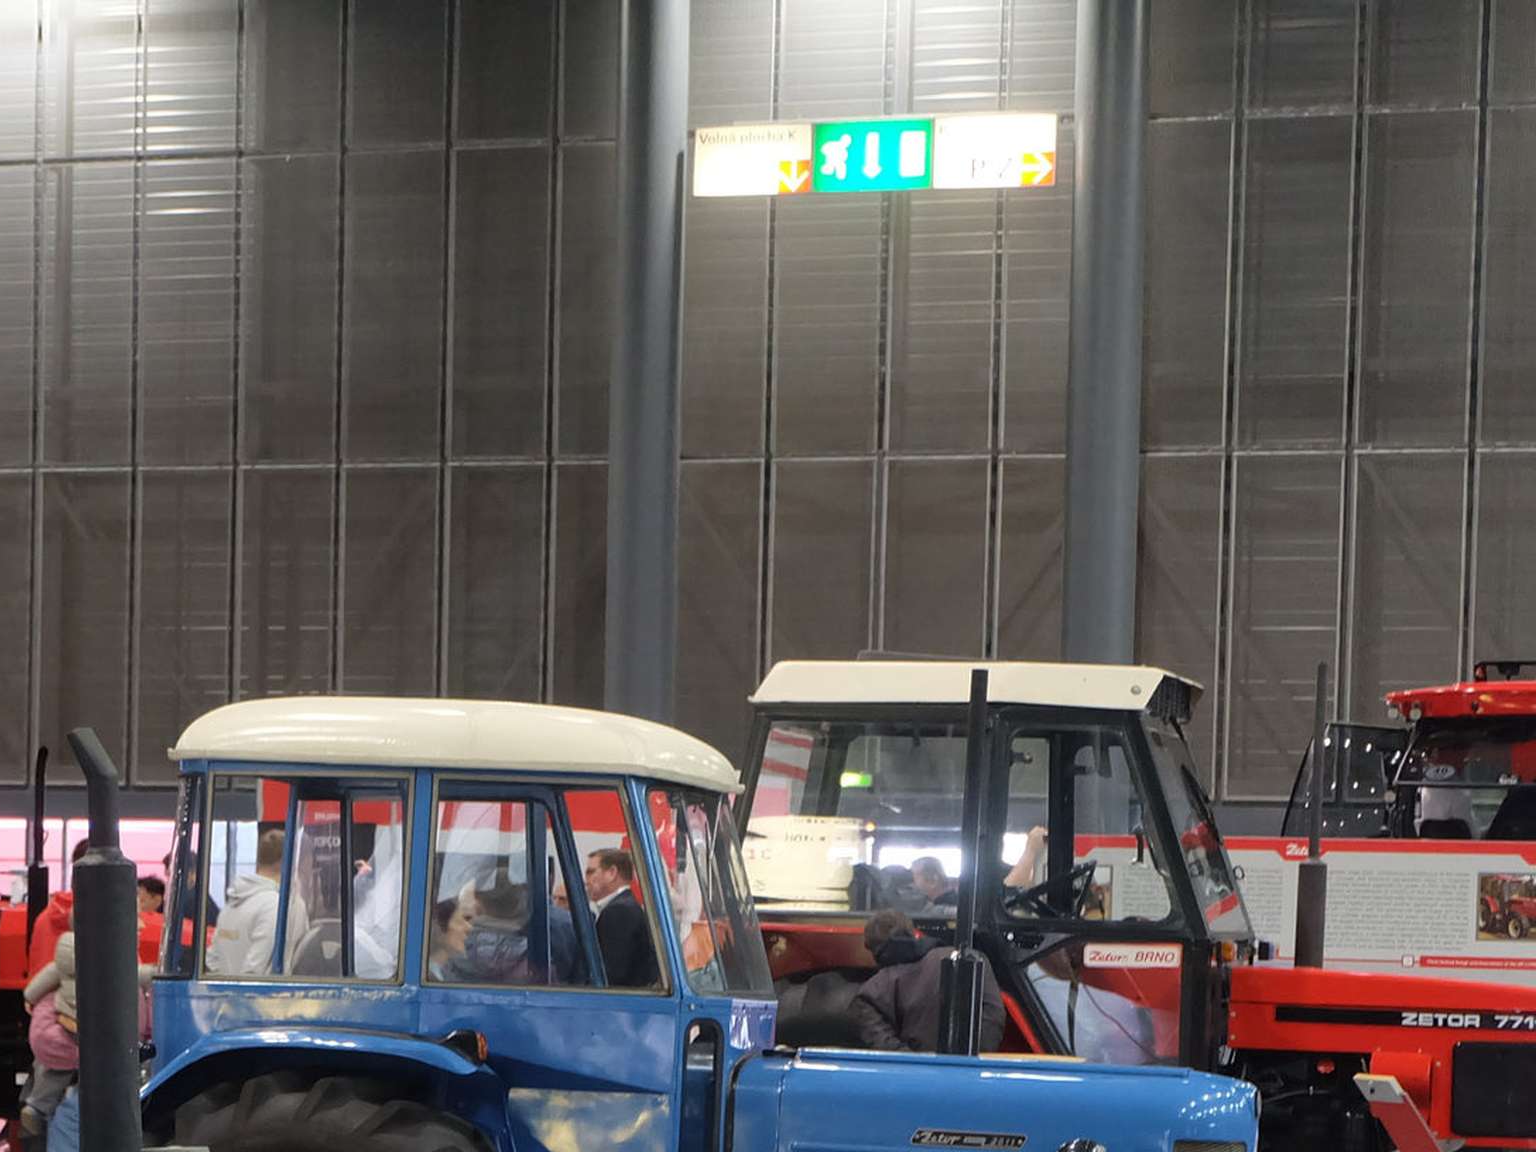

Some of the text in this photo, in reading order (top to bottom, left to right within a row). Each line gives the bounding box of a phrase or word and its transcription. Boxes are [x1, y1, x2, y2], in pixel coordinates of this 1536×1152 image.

[1134, 951, 1175, 964] BRNO
[1401, 1011, 1481, 1029] ZETOR
[917, 1131, 962, 1146] Zetor
